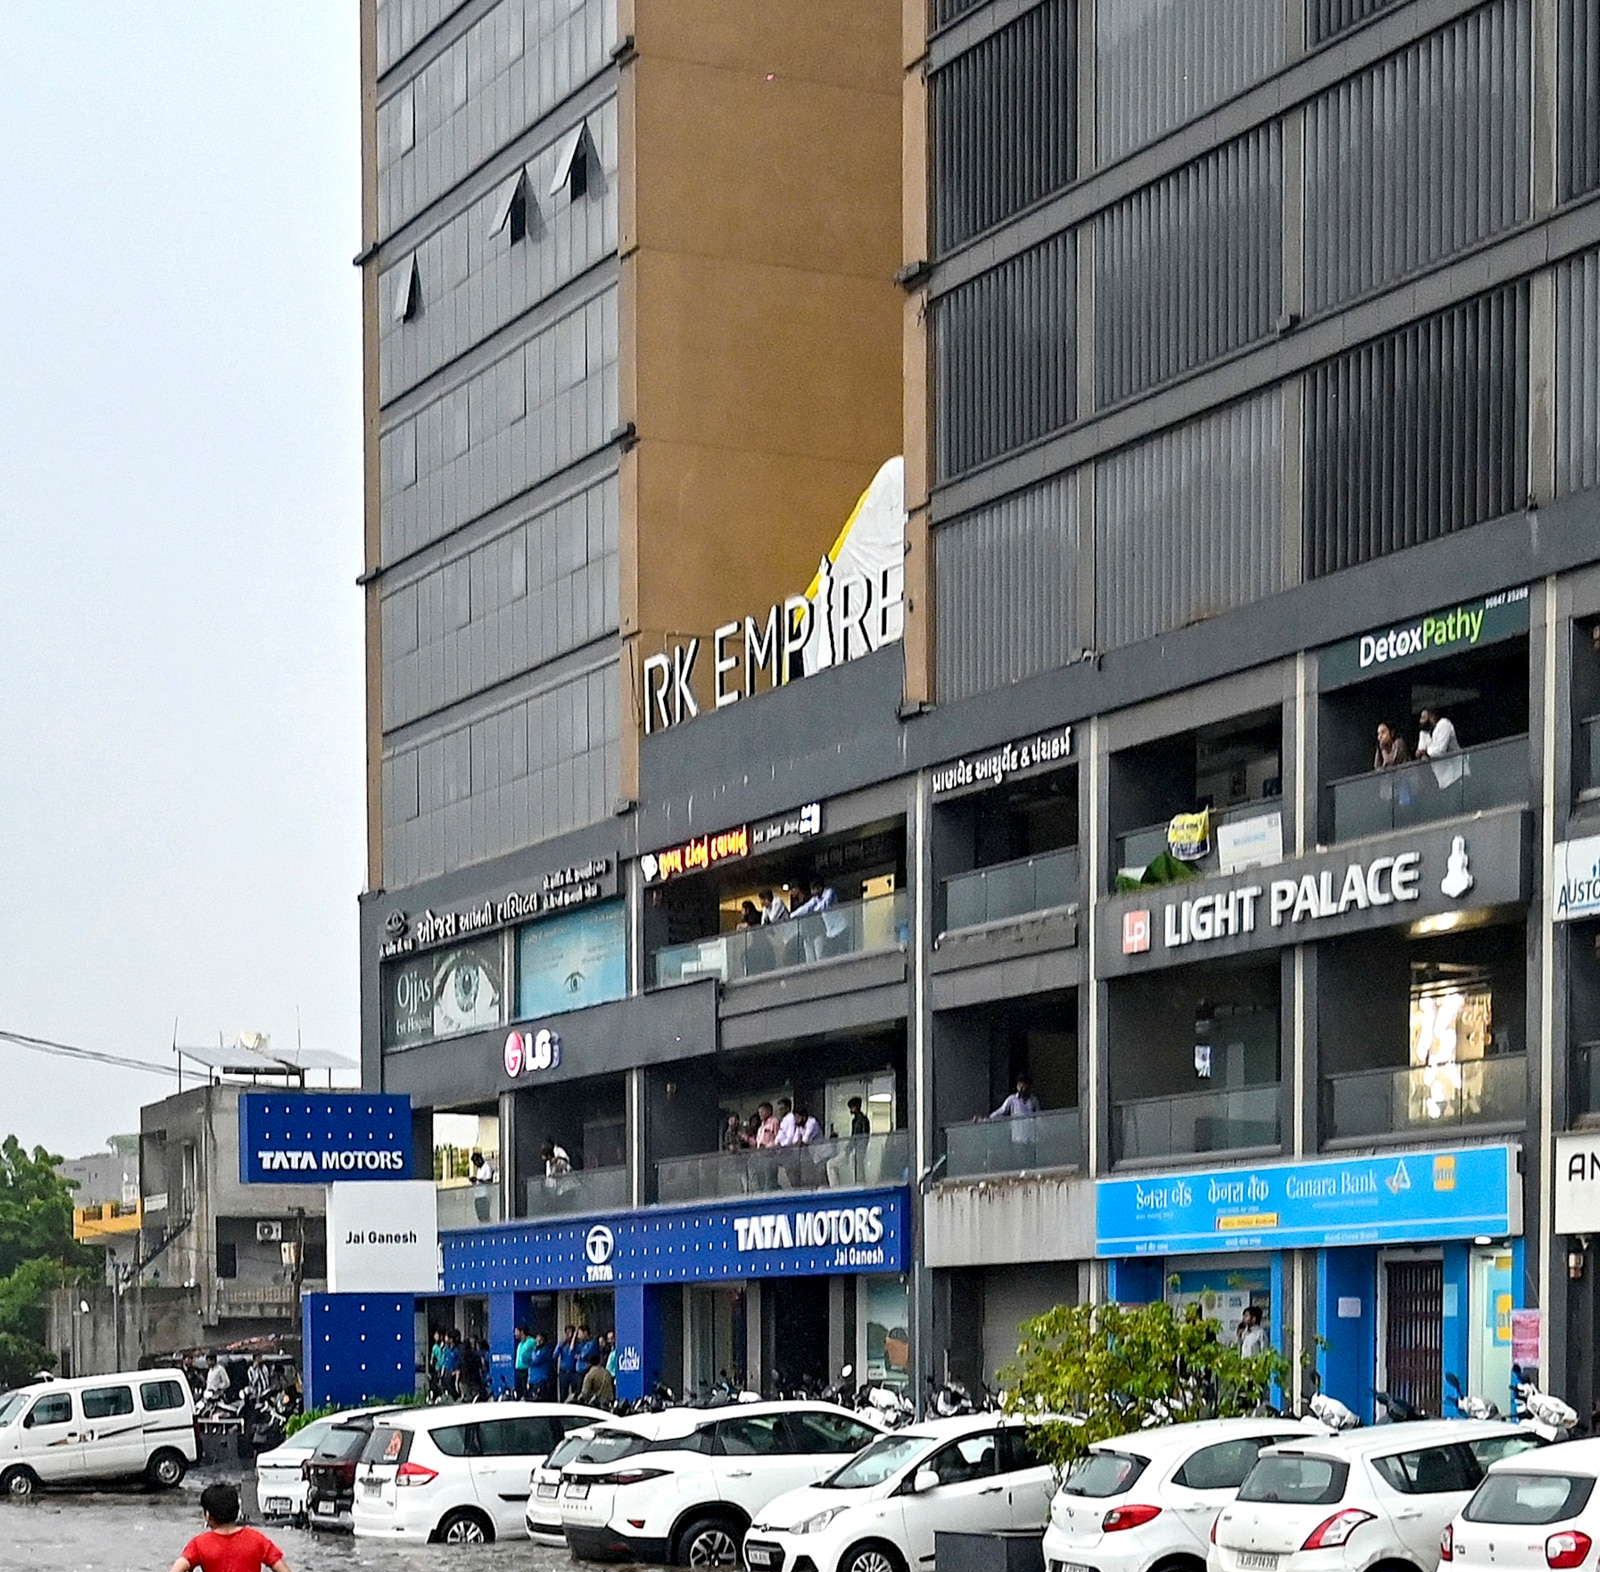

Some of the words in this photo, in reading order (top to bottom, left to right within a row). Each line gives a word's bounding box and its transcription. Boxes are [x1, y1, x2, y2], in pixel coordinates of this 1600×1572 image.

[1360, 606, 1485, 669] DetoxPathy
[644, 637, 699, 734] RK
[1164, 885, 1262, 948] LIGHT
[1270, 851, 1420, 927] PALACE
[524, 1029, 551, 1071] LG
[258, 1151, 317, 1170] TATA
[322, 1150, 404, 1170] MOTORS
[1286, 1175, 1337, 1200] Canara
[1341, 1169, 1378, 1194] Bank
[346, 1231, 364, 1244] Jai
[368, 1230, 417, 1244] Ganesh
[734, 1214, 794, 1251] TATA
[796, 1206, 883, 1247] MOTORS
[586, 1265, 613, 1281] TATA
[834, 1248, 848, 1266] Jai
[849, 1247, 884, 1265] Ganesh
